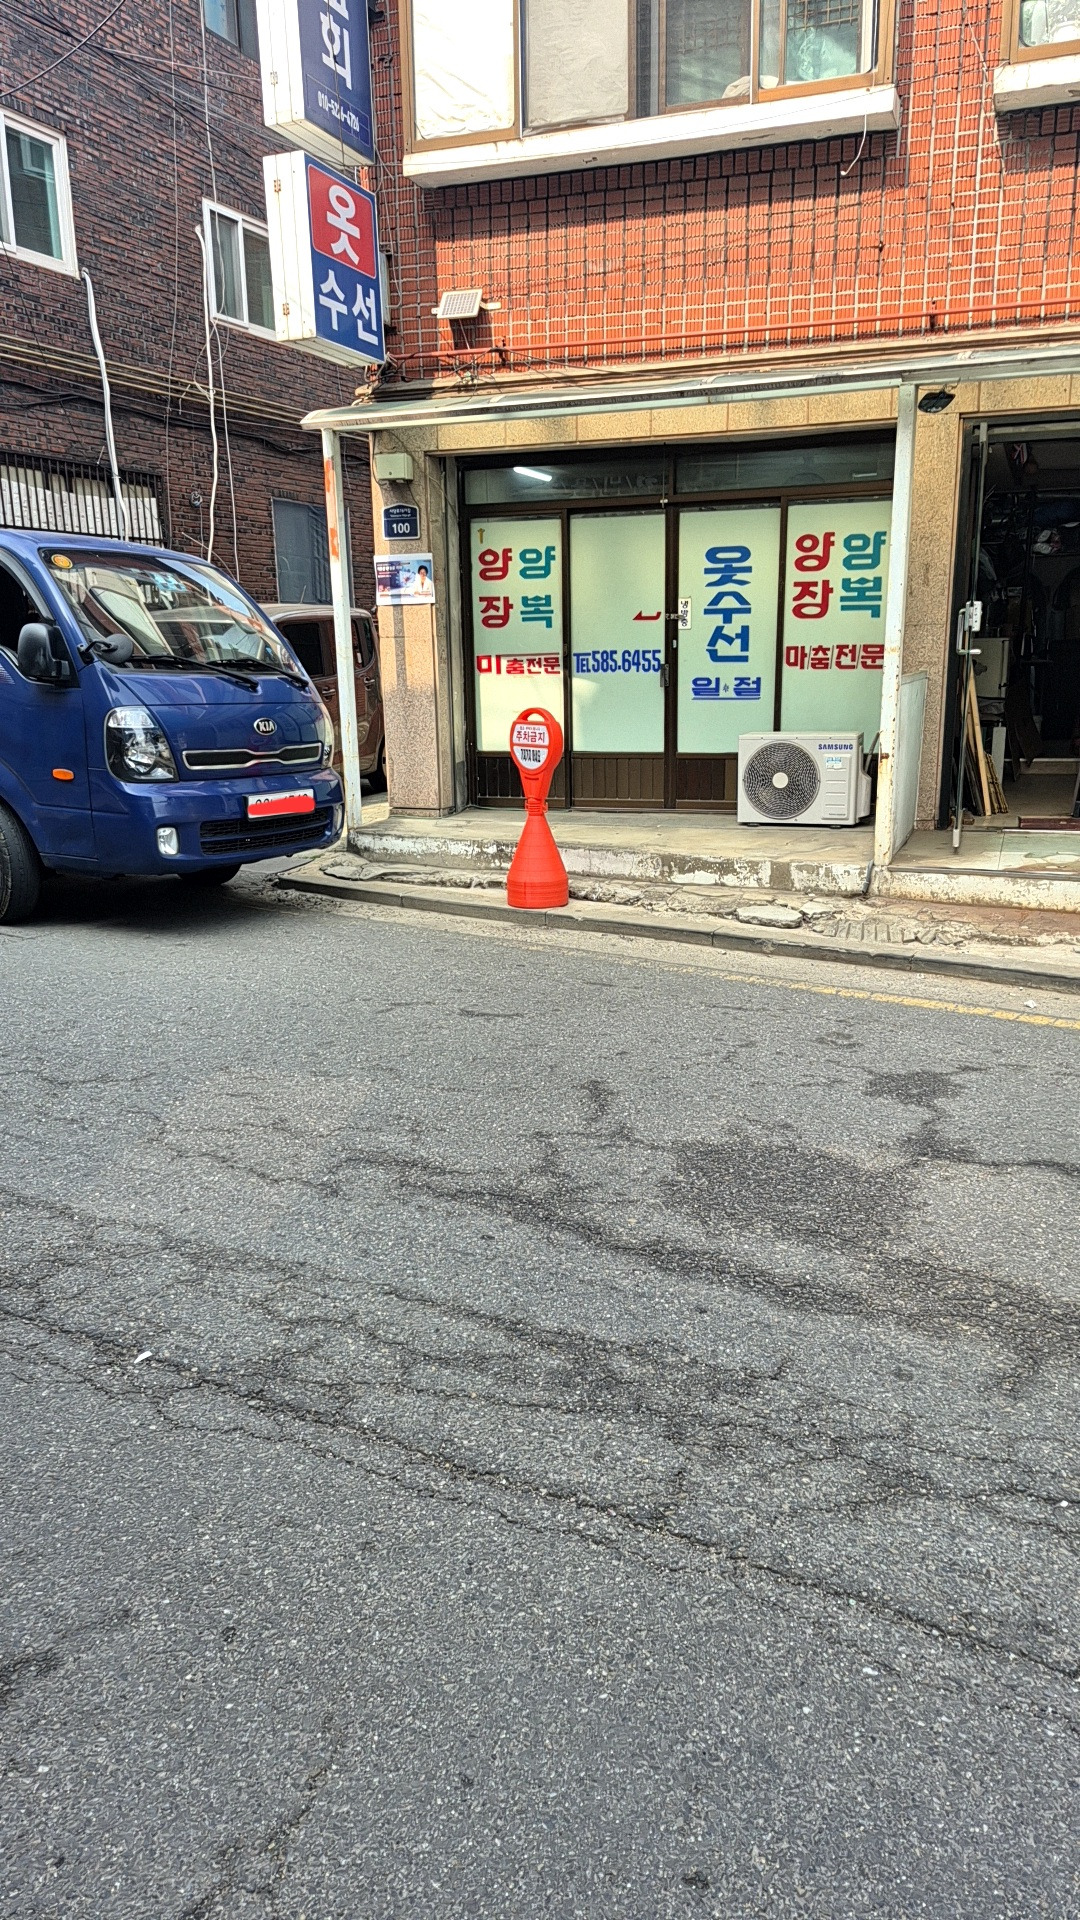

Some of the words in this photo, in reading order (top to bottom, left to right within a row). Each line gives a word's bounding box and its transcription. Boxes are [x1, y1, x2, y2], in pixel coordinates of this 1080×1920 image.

[326, 184, 361, 266] 옷
[318, 268, 379, 346] 수선
[392, 523, 410, 534] 100
[259, 721, 274, 731] KIA
[515, 730, 546, 744] 주차금지
